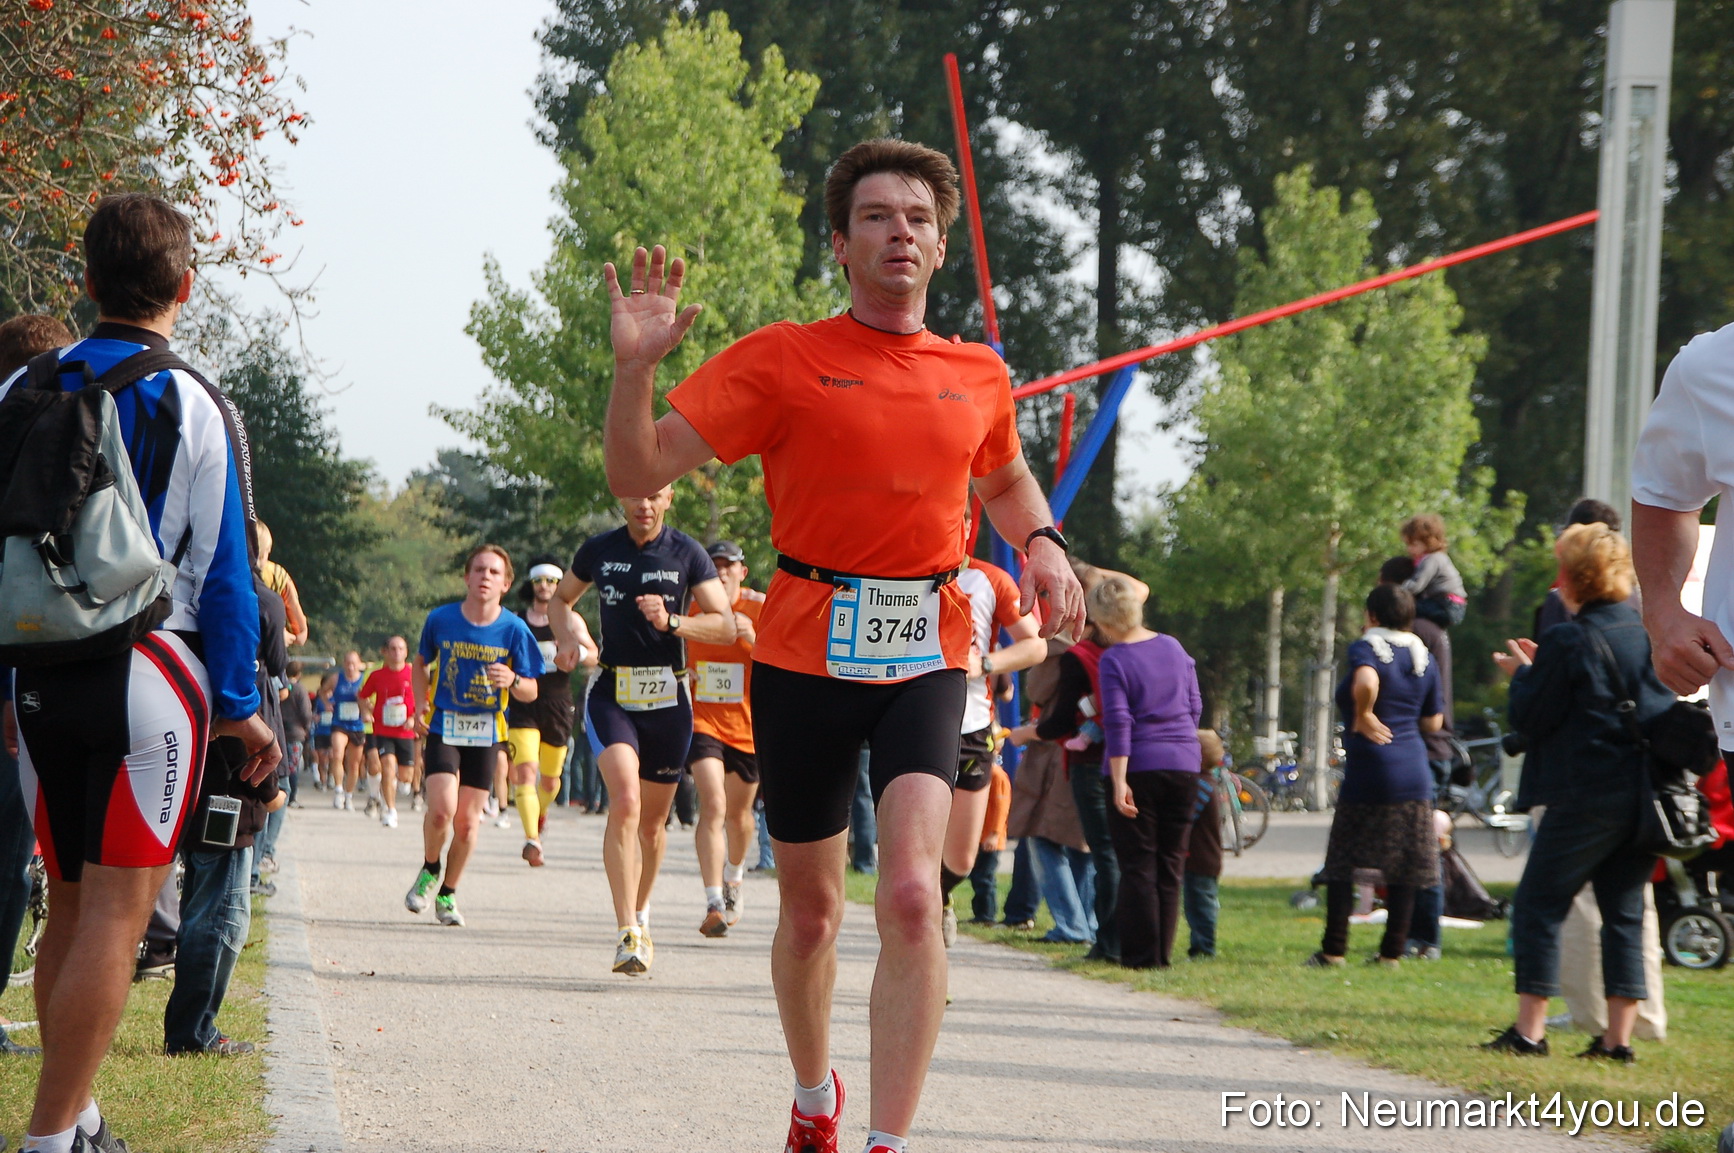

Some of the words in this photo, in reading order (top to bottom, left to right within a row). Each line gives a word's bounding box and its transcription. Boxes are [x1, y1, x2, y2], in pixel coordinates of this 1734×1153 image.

[868, 587, 919, 607] Thomas
[838, 613, 846, 627] B
[866, 616, 928, 644] 3748
[632, 666, 664, 676] Gerhard
[897, 660, 943, 672] PFLEIDERER
[638, 680, 668, 695] 727
[717, 678, 732, 690] 30
[457, 719, 487, 732] 3747
[159, 730, 179, 824] Giordana
